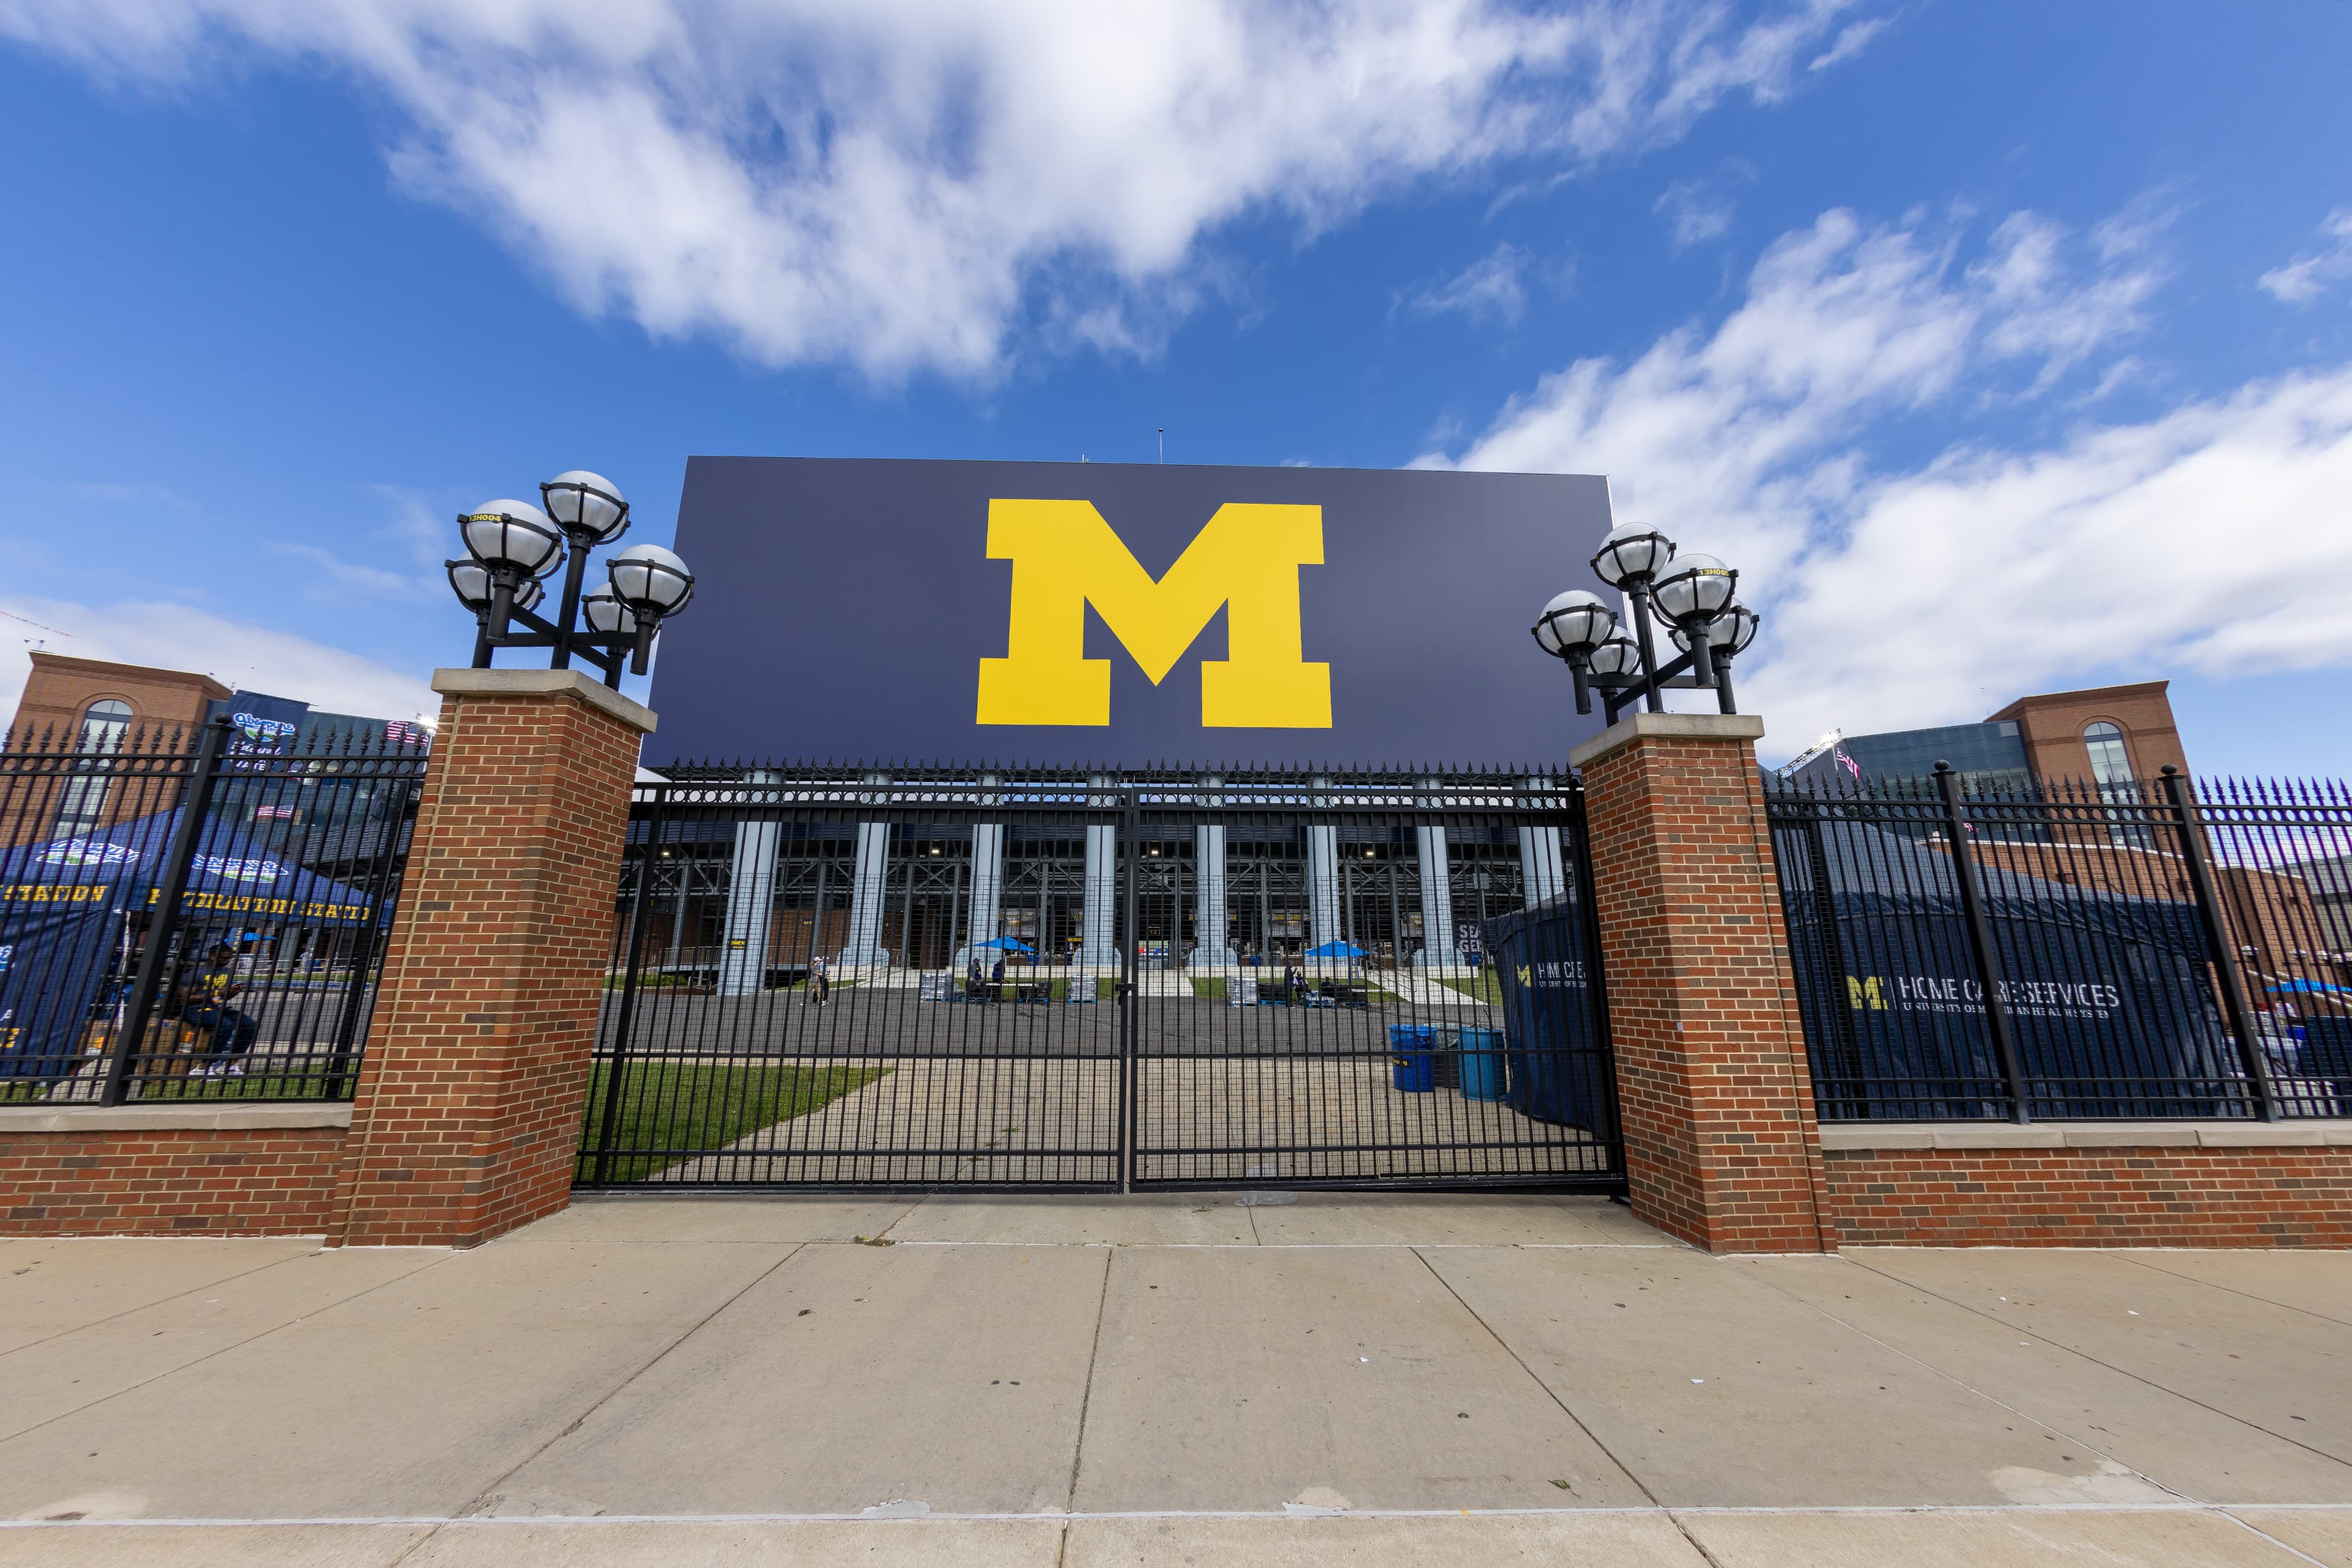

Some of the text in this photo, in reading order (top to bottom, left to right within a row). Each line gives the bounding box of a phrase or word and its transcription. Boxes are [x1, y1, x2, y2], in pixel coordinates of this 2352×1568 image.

[976, 498, 1333, 728] M
[147, 889, 370, 921] HDRATION STATIO
[1846, 975, 1889, 1010] M
[1899, 977, 1959, 1000] HOME
[2022, 981, 2120, 1007] SERVICES
[1964, 1004, 1976, 1013] OF
[1978, 1005, 2030, 1015] MIGAN
[2033, 1007, 2072, 1017] HEALH
[2073, 1008, 2110, 1019] SYSEM
